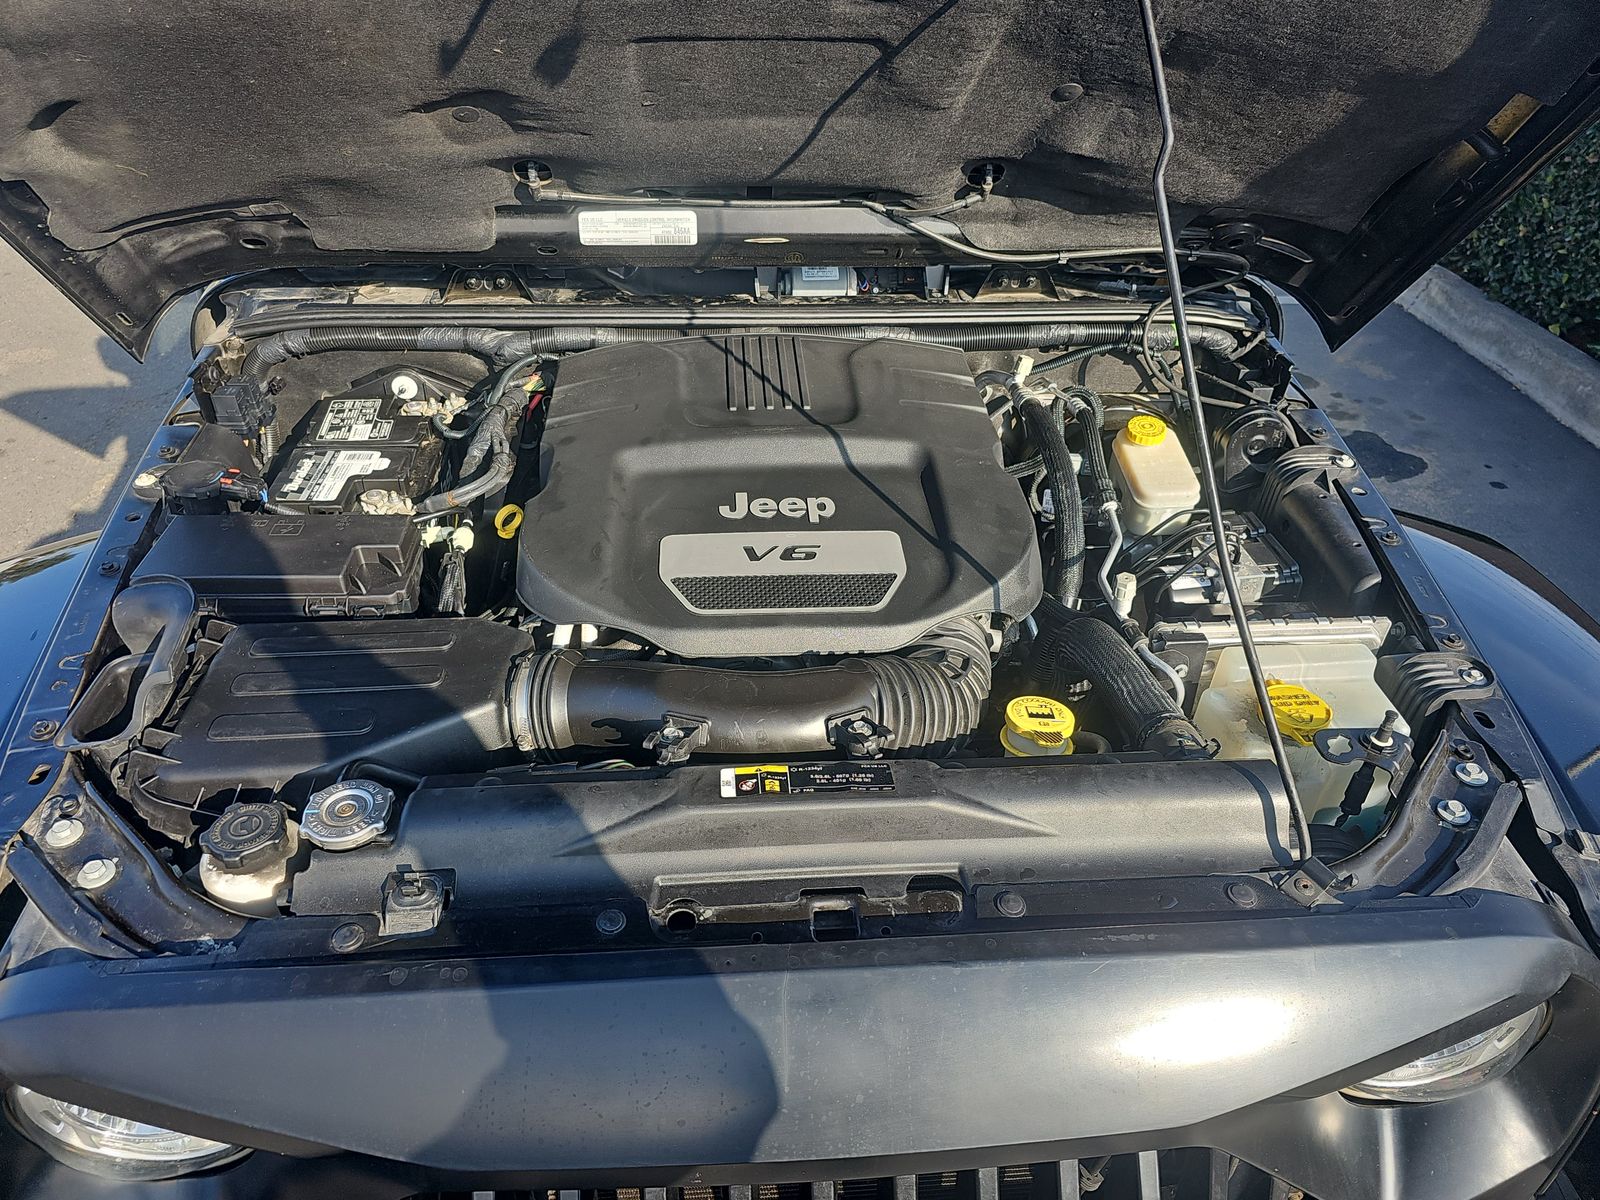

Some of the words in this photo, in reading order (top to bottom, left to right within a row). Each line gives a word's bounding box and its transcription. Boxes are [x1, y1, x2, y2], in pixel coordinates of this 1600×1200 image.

[280, 458, 316, 492] Duralast
[718, 491, 836, 524] Jeep
[743, 544, 821, 562] V6
